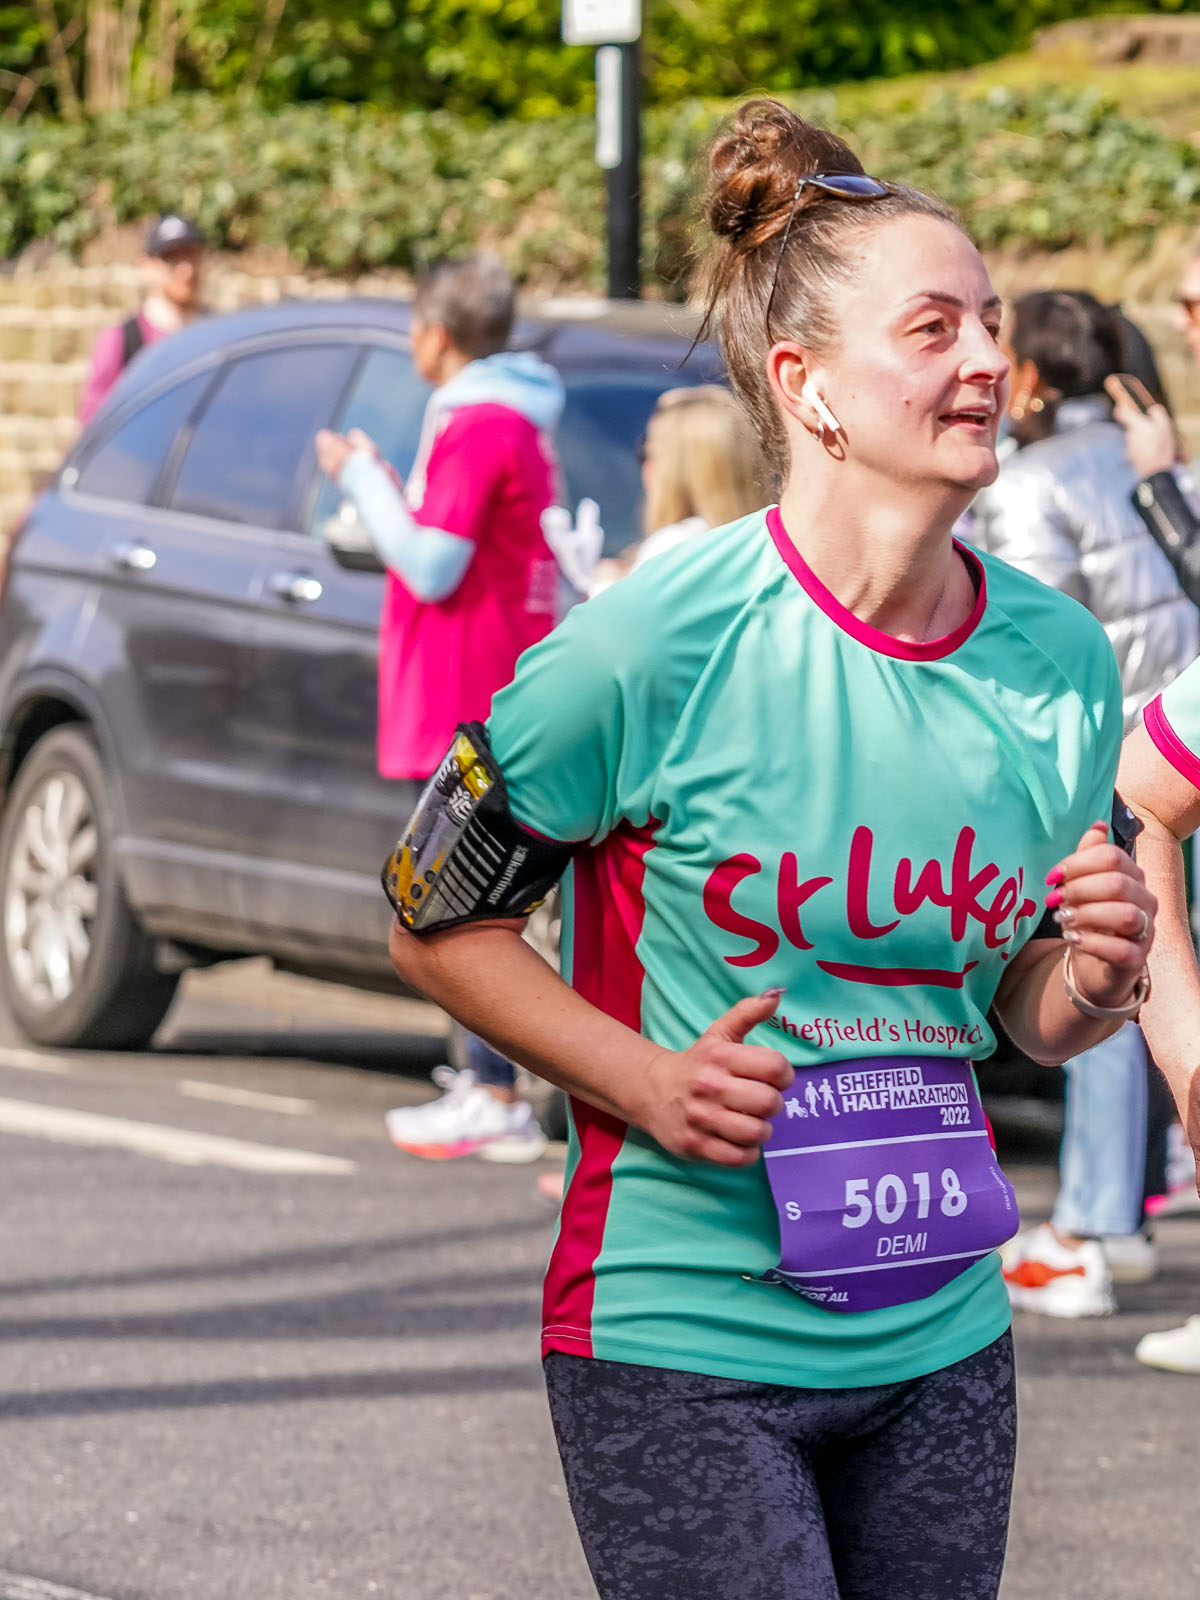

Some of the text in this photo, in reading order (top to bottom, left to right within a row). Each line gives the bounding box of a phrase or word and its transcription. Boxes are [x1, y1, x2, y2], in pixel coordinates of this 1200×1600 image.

[702, 851, 835, 968] St
[839, 1069, 921, 1093] SHEFFIELD
[842, 1085, 968, 1113] HALF MARATHON
[940, 1105, 971, 1126] 2022
[841, 1167, 968, 1229] 5018
[785, 1201, 802, 1221] S
[875, 1233, 928, 1258] DEMI
[827, 1291, 849, 1303] ALL
